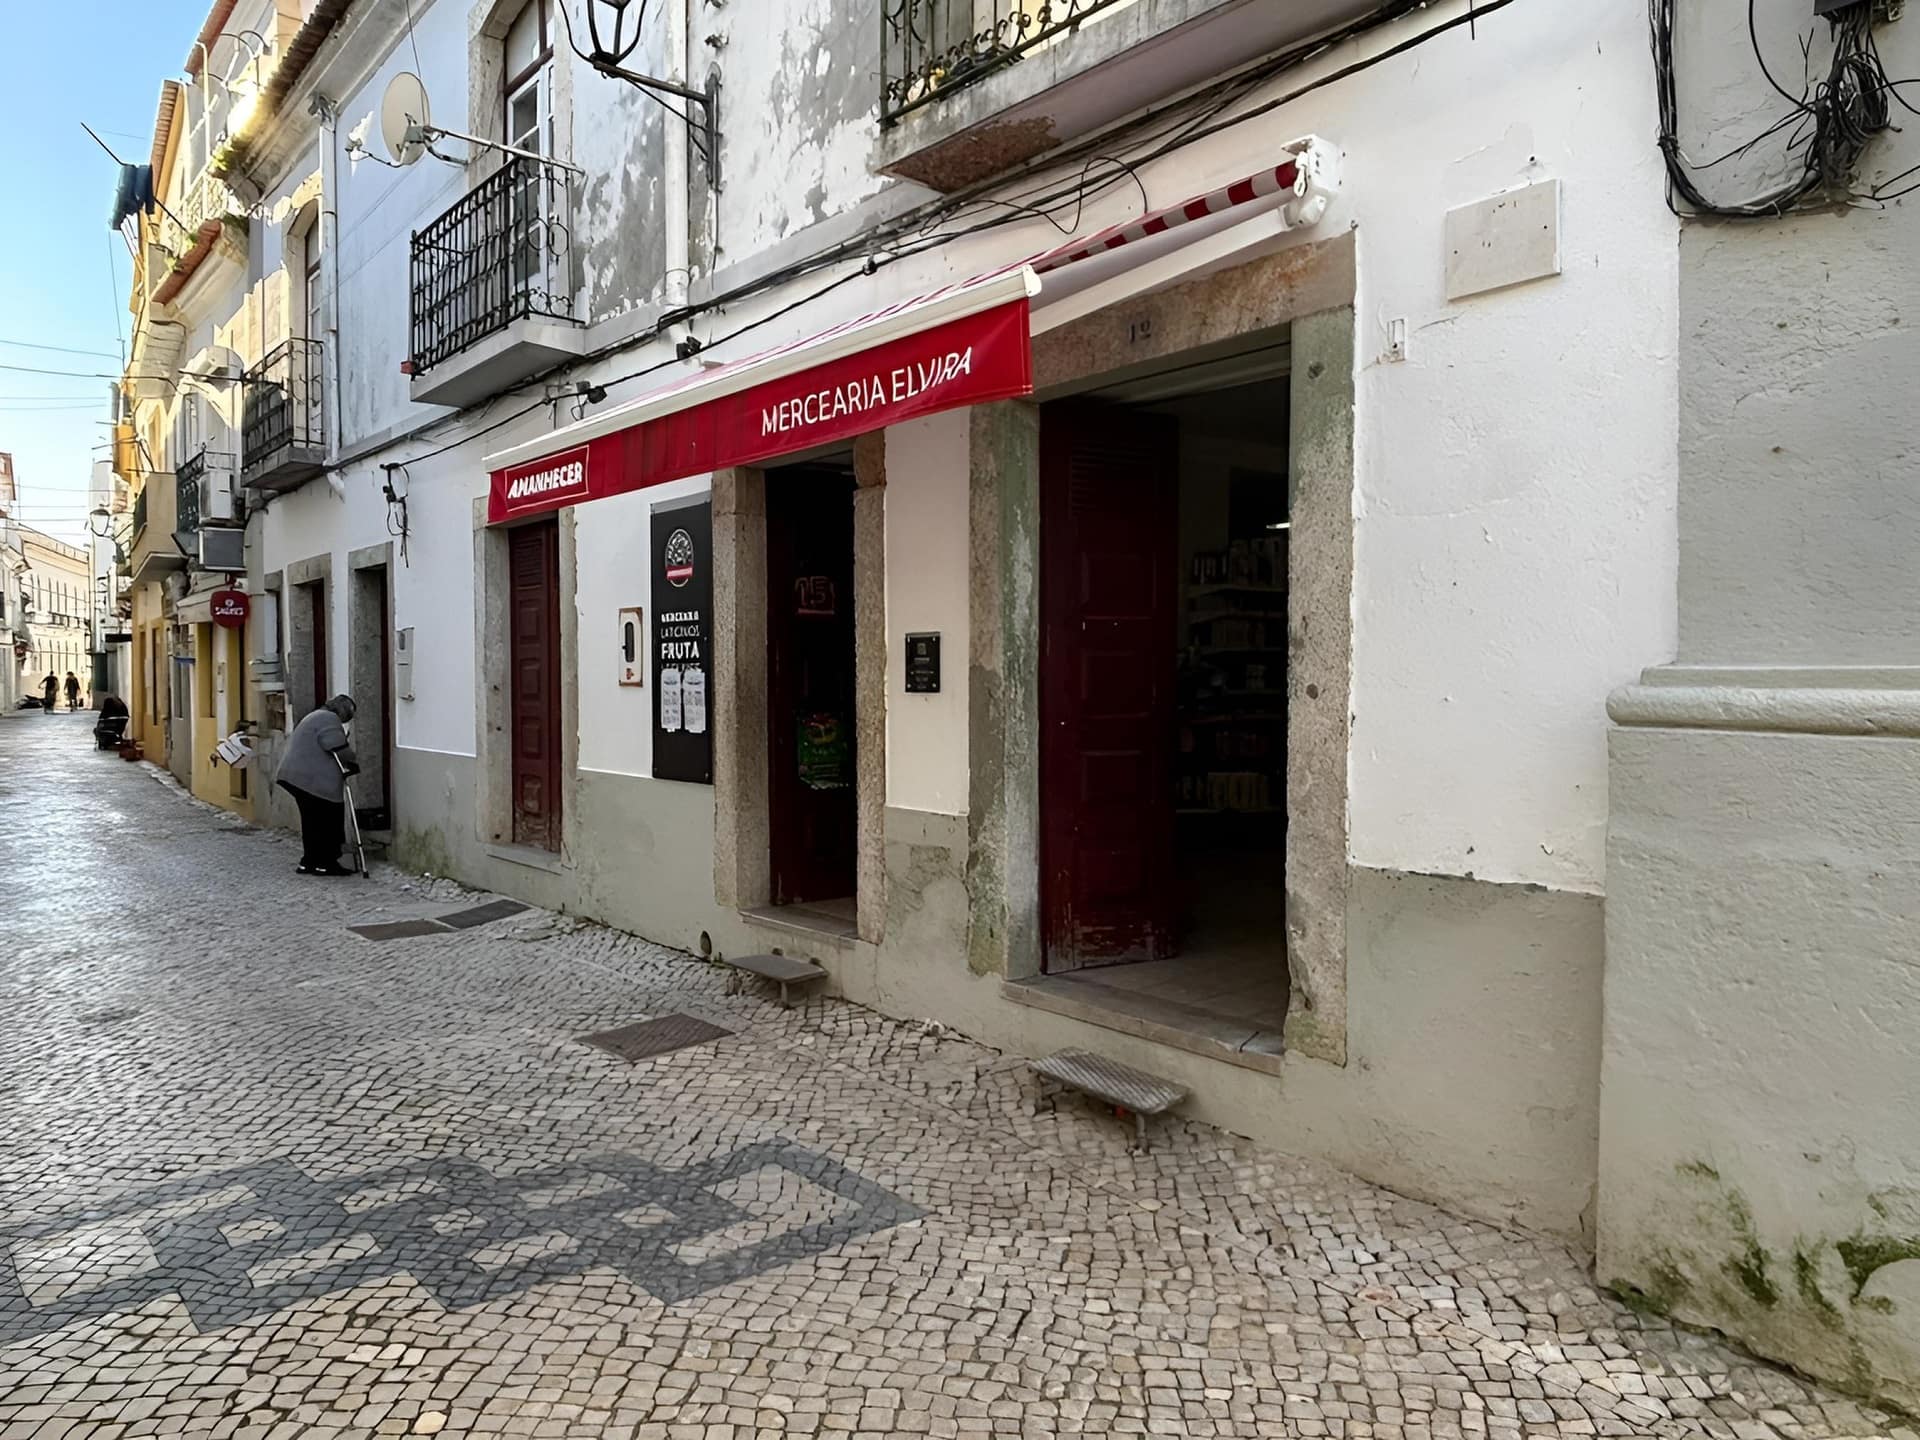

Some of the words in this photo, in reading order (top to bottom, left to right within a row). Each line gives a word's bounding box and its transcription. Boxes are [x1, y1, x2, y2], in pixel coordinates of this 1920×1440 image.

[761, 374, 886, 437] MERCEARIA
[892, 346, 972, 402] ELVIRA
[507, 461, 583, 499] AMANHECER
[661, 641, 700, 660] FRUTA
